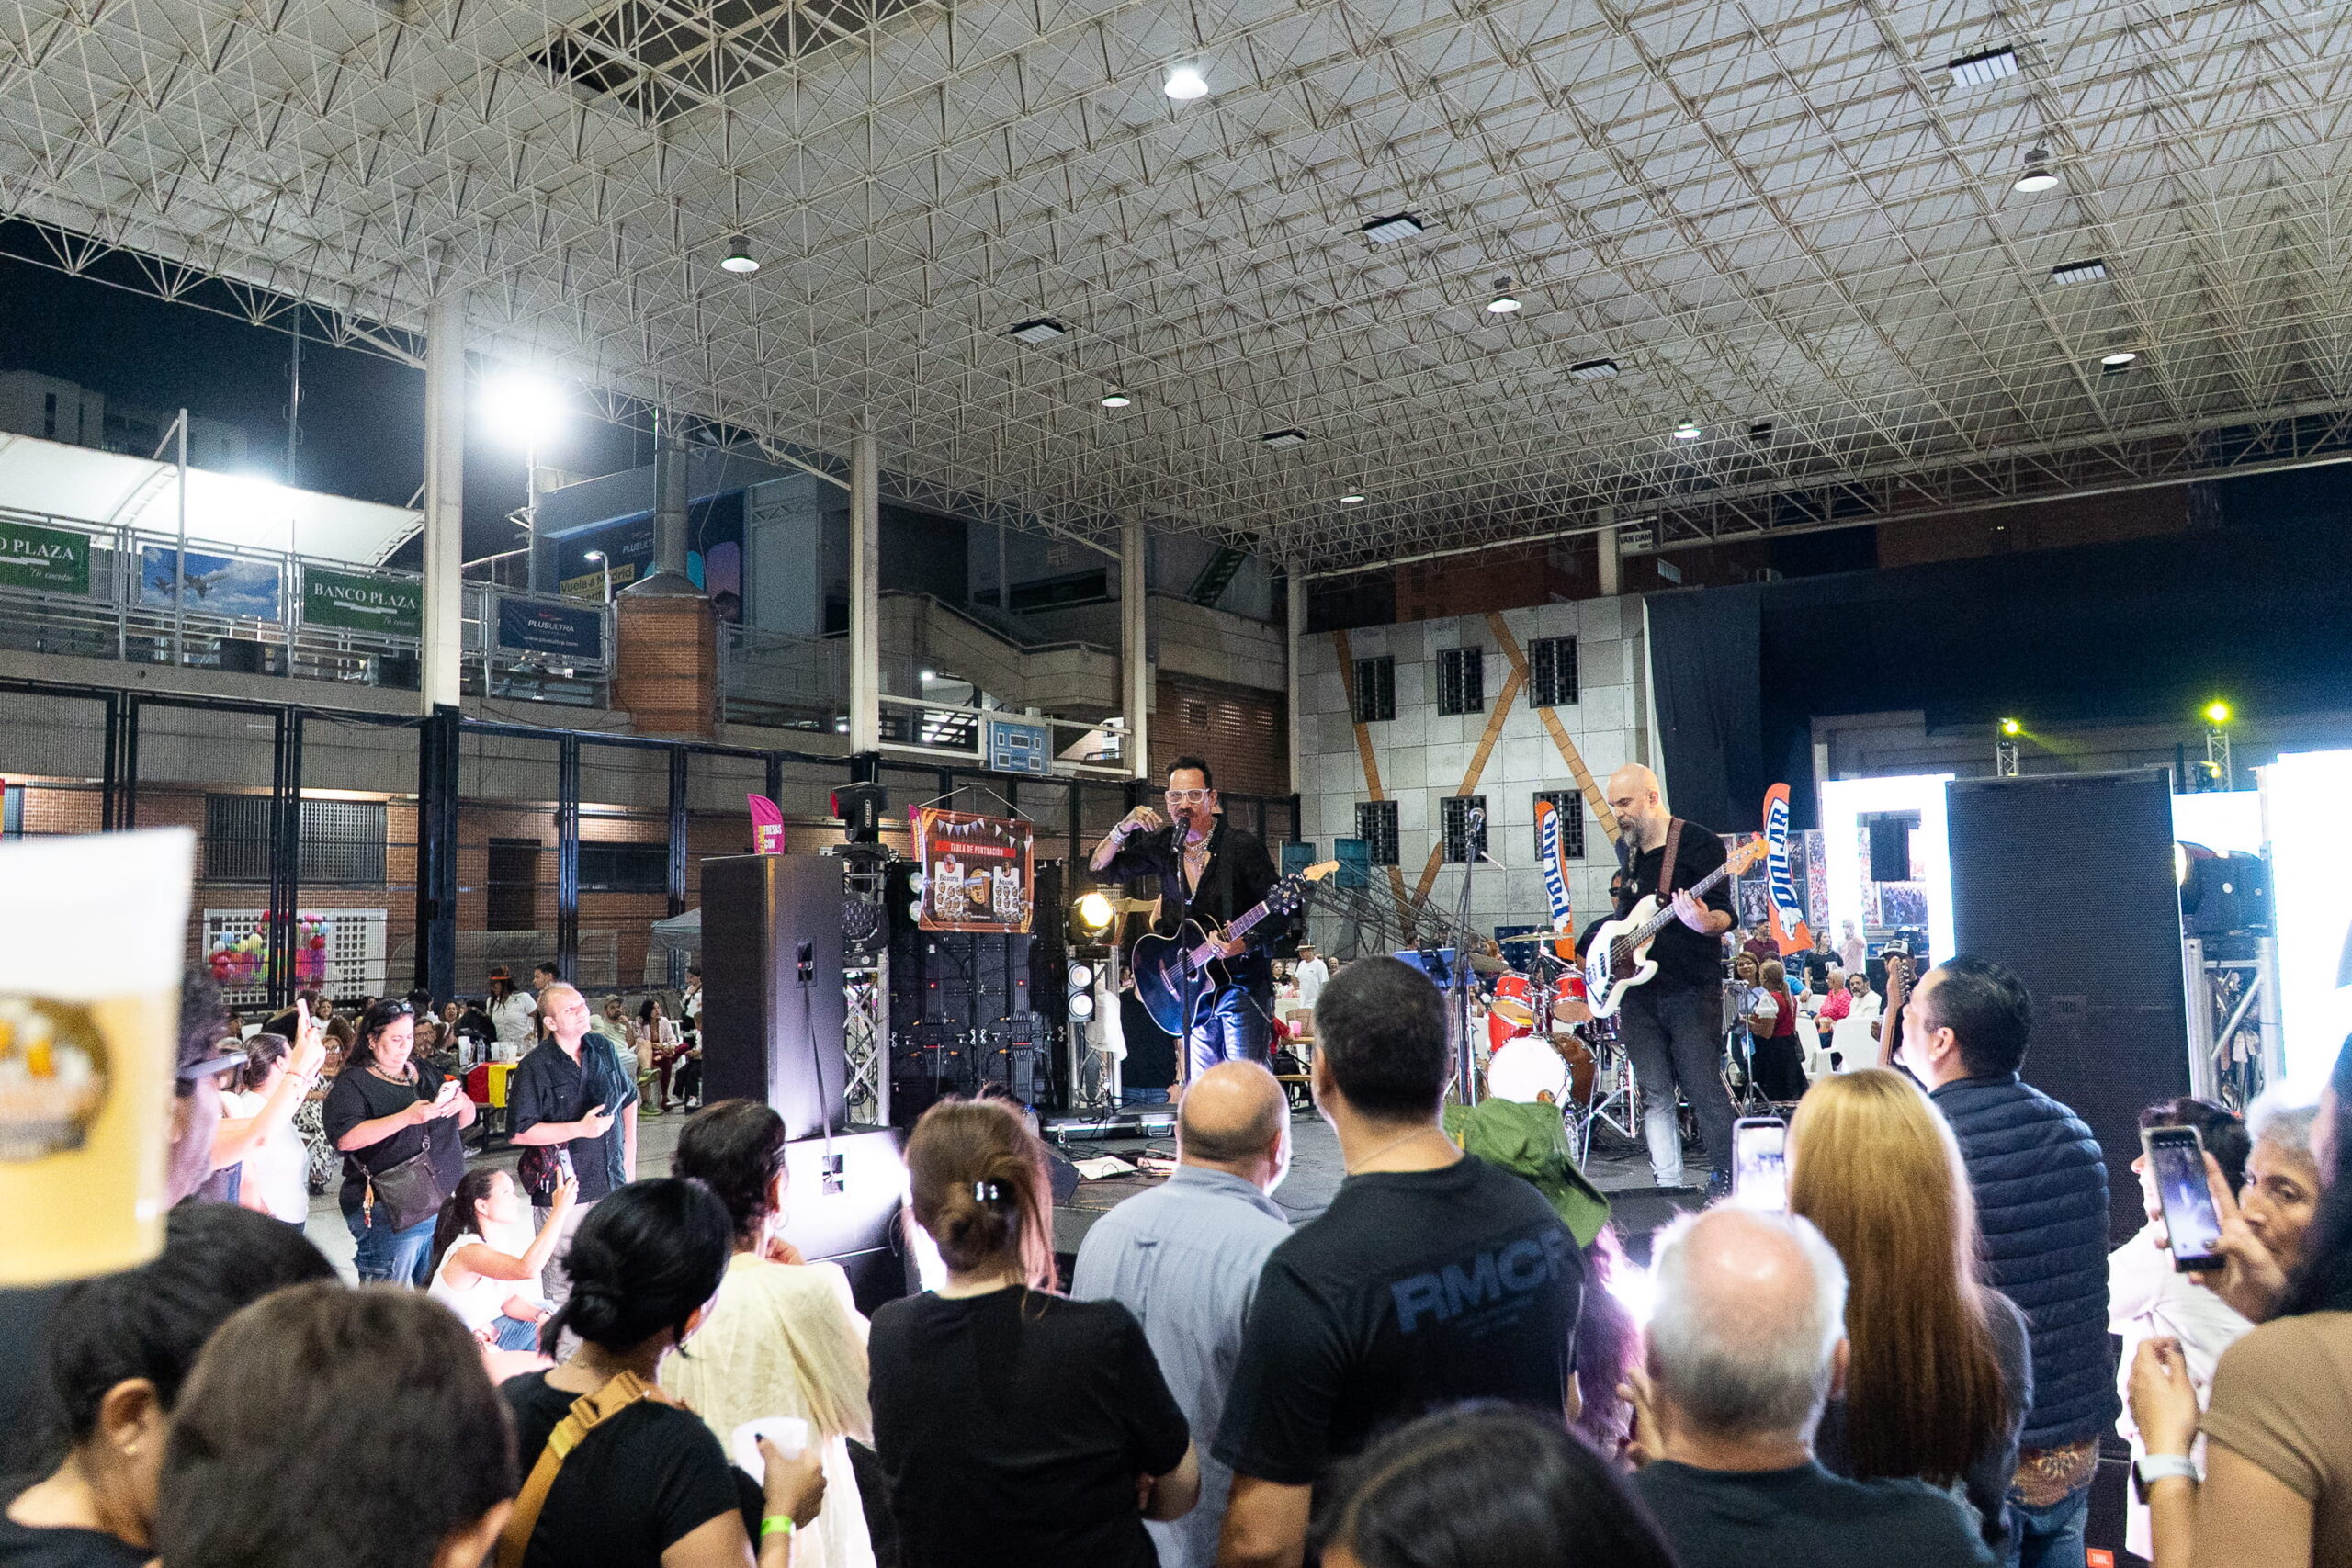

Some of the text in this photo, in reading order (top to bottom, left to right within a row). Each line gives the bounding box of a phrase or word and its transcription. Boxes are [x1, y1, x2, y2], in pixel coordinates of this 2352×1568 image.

[13, 538, 74, 561] PLAZA
[560, 567, 632, 593] Vuela a Mdrid
[314, 582, 416, 609] BANCO PLAZA
[528, 619, 574, 632] PLUSULTRA
